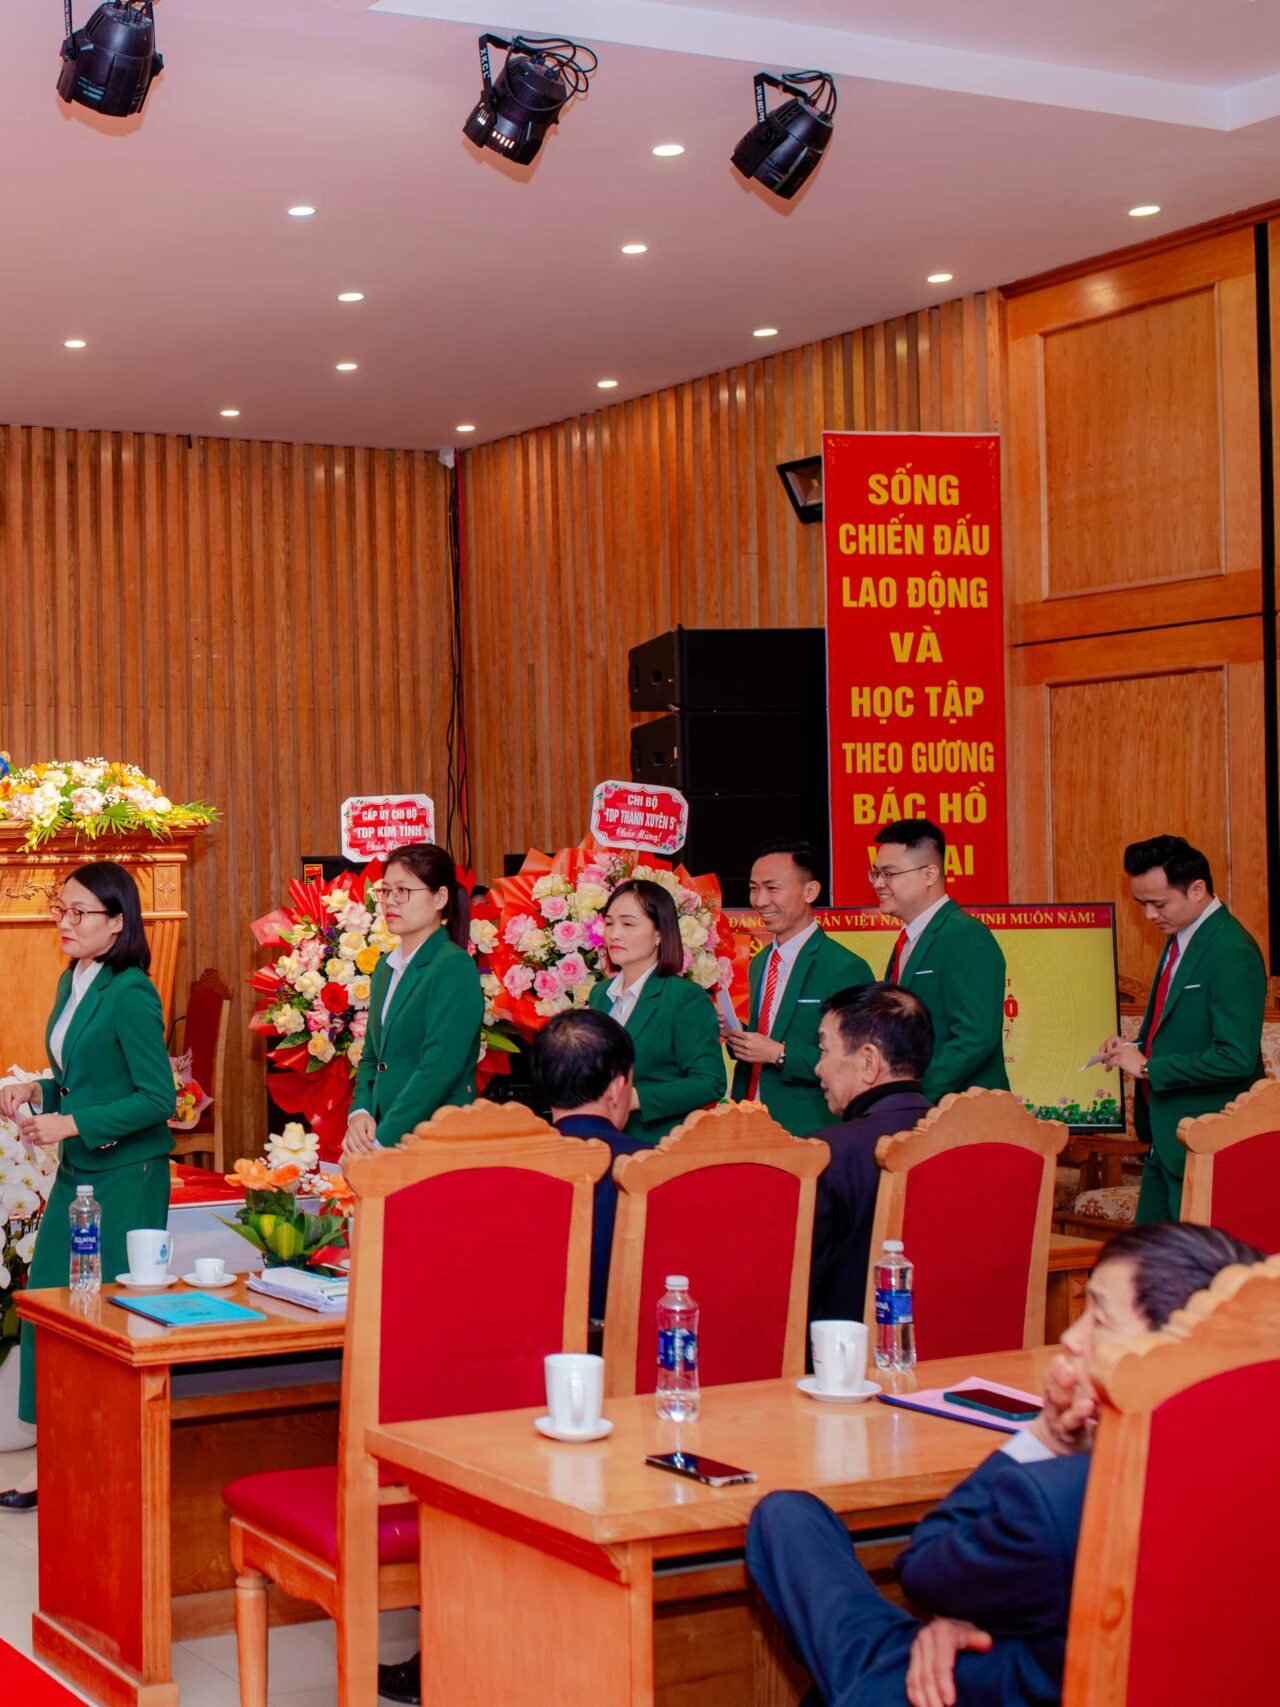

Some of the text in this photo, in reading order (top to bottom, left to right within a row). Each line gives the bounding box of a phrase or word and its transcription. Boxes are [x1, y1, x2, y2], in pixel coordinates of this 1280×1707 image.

[480, 48, 489, 79] XKCL
[868, 463, 960, 506] SỐNG
[839, 513, 990, 555] CHIẾN ĐẤU
[842, 570, 988, 615] LAO ĐỘNG
[890, 625, 944, 663] VÀ
[851, 680, 984, 724] HỌC TẬP
[842, 739, 994, 773] THEO GƯƠNG
[362, 807, 378, 821] CẤP
[391, 808, 404, 820] CHI
[406, 807, 417, 821] BỘ
[621, 810, 644, 826] THANH
[627, 794, 658, 810] CHI BỘ
[853, 782, 987, 824] BÁC HỒ
[377, 825, 396, 838] KIM
[944, 845, 974, 882] ẠI
[845, 914, 877, 930] VIỆT
[881, 914, 903, 926] NA
[1010, 910, 1053, 924] MUÔN
